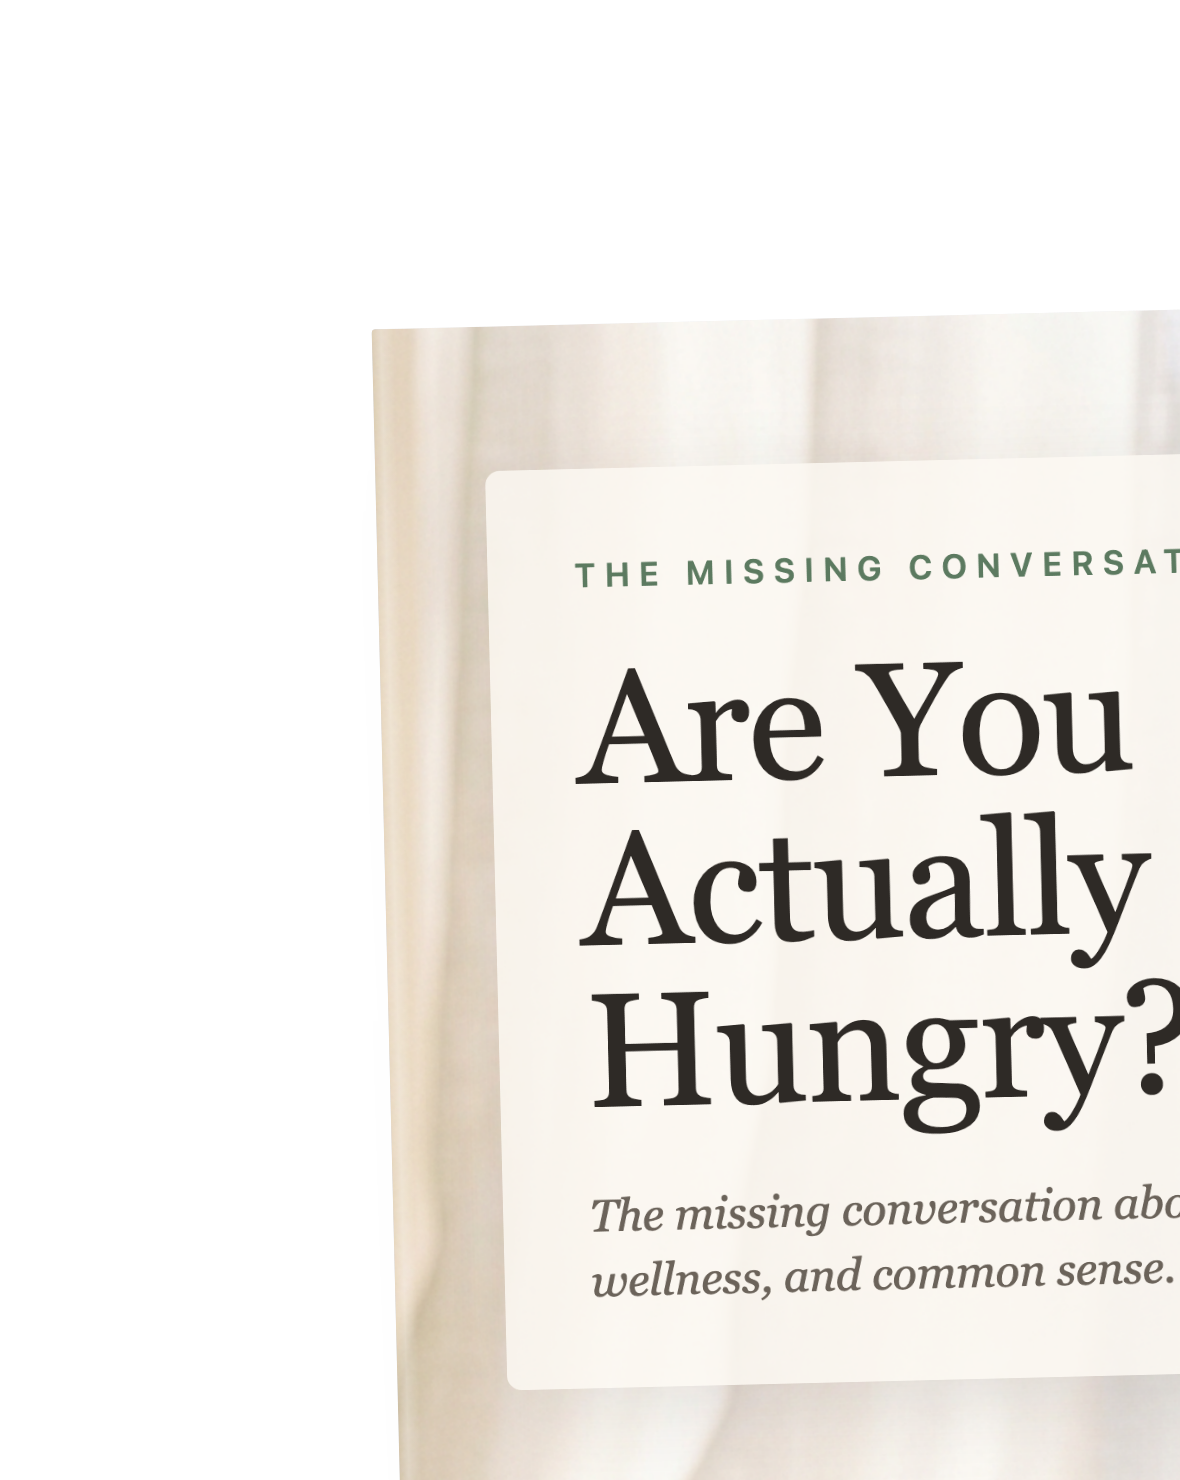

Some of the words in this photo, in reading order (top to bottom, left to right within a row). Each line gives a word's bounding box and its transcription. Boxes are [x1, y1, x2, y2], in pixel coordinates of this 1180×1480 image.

[574, 560, 658, 588] THE
[687, 555, 881, 586] MISSING
[574, 667, 825, 785] Are
[854, 661, 1134, 778] You
[578, 810, 1153, 970] Actually
[591, 1195, 665, 1233] The
[675, 1192, 831, 1238] missing
[842, 1186, 1104, 1227] conversation
[591, 1259, 773, 1302] wellness,
[784, 1254, 863, 1294] and
[872, 1262, 1047, 1291] common
[1056, 1259, 1175, 1287] sense.
